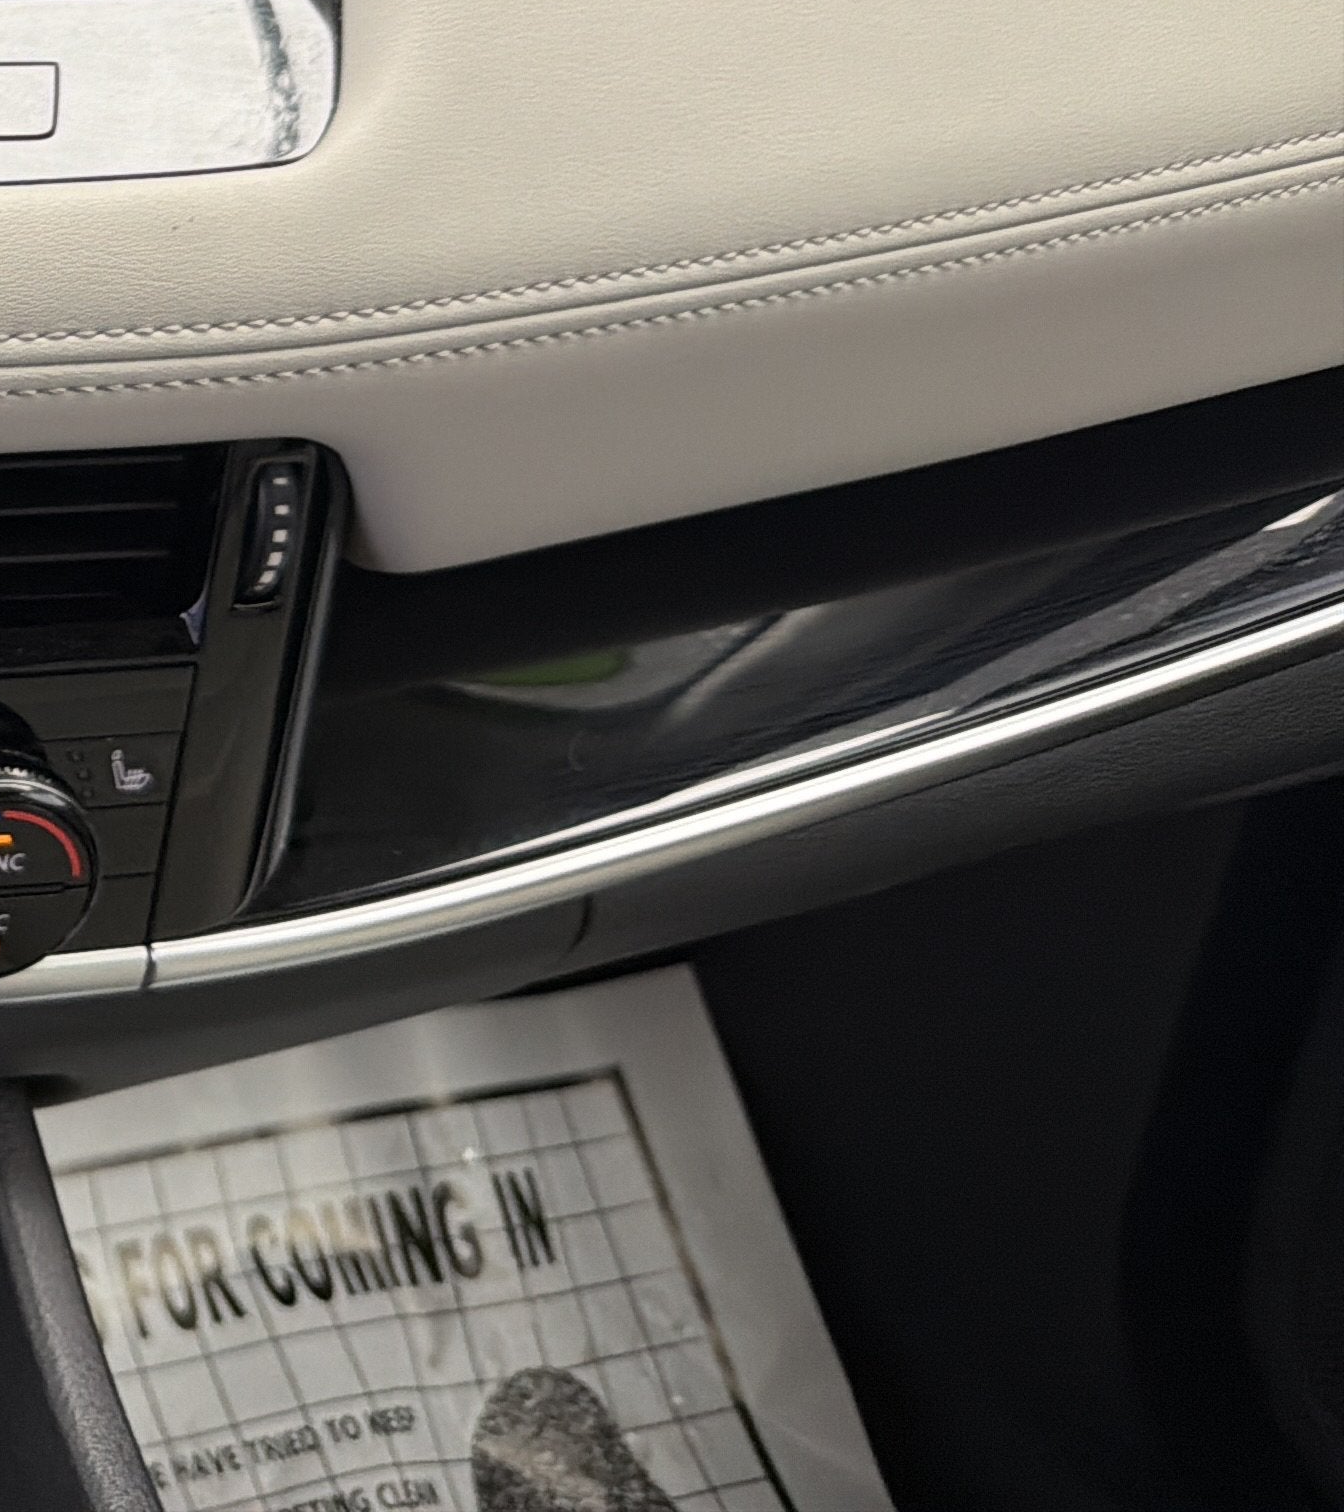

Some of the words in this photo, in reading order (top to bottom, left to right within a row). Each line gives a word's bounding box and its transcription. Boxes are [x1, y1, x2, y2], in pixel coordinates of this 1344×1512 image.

[115, 1225, 248, 1340] FOR
[245, 1181, 484, 1308] COMING
[491, 1167, 557, 1271] IN
[172, 1445, 242, 1481] HAVE
[244, 1424, 321, 1463] TRIED
[325, 1414, 362, 1443] TO
